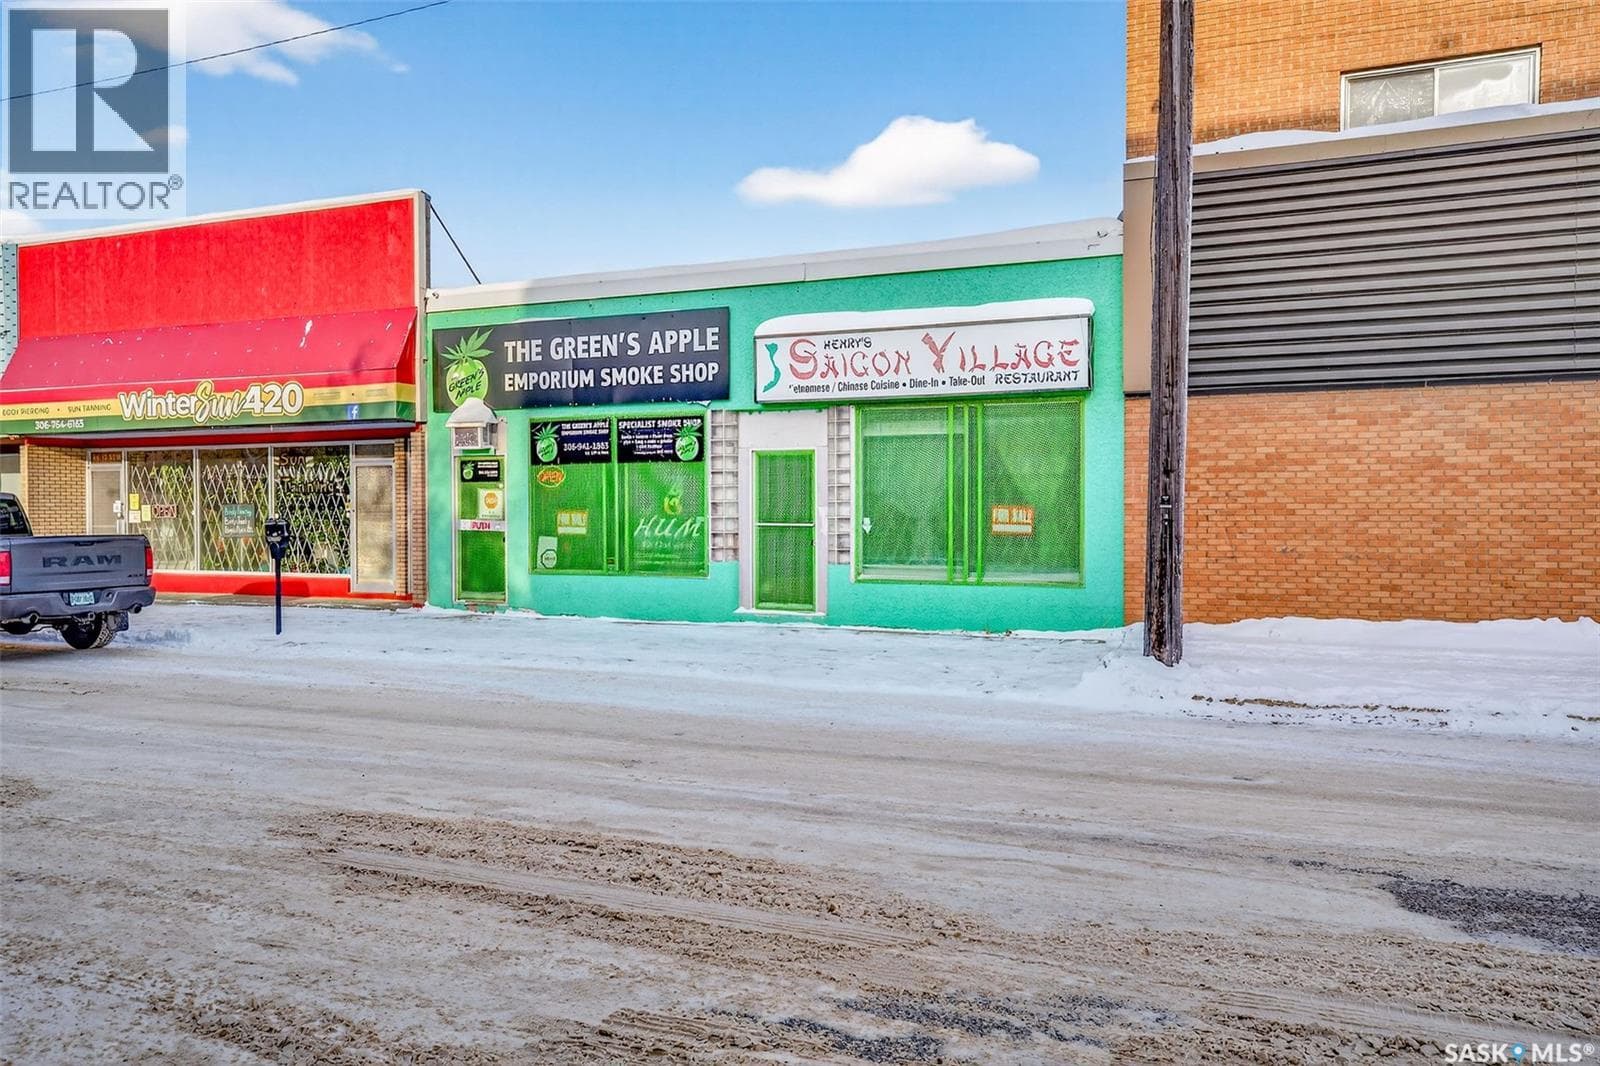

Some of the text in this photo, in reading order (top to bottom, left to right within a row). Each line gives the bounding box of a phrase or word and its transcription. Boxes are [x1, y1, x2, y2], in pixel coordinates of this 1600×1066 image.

[504, 327, 720, 363] THE GREEN'S APPLE
[823, 337, 872, 350] HENRY'S
[504, 362, 719, 391] EMPORIUM SMOKE SHOP
[909, 376, 939, 388] Dine-In
[949, 374, 986, 387] Take-Out
[994, 370, 1080, 385] RESTAURANT
[42, 555, 121, 568] RAM
